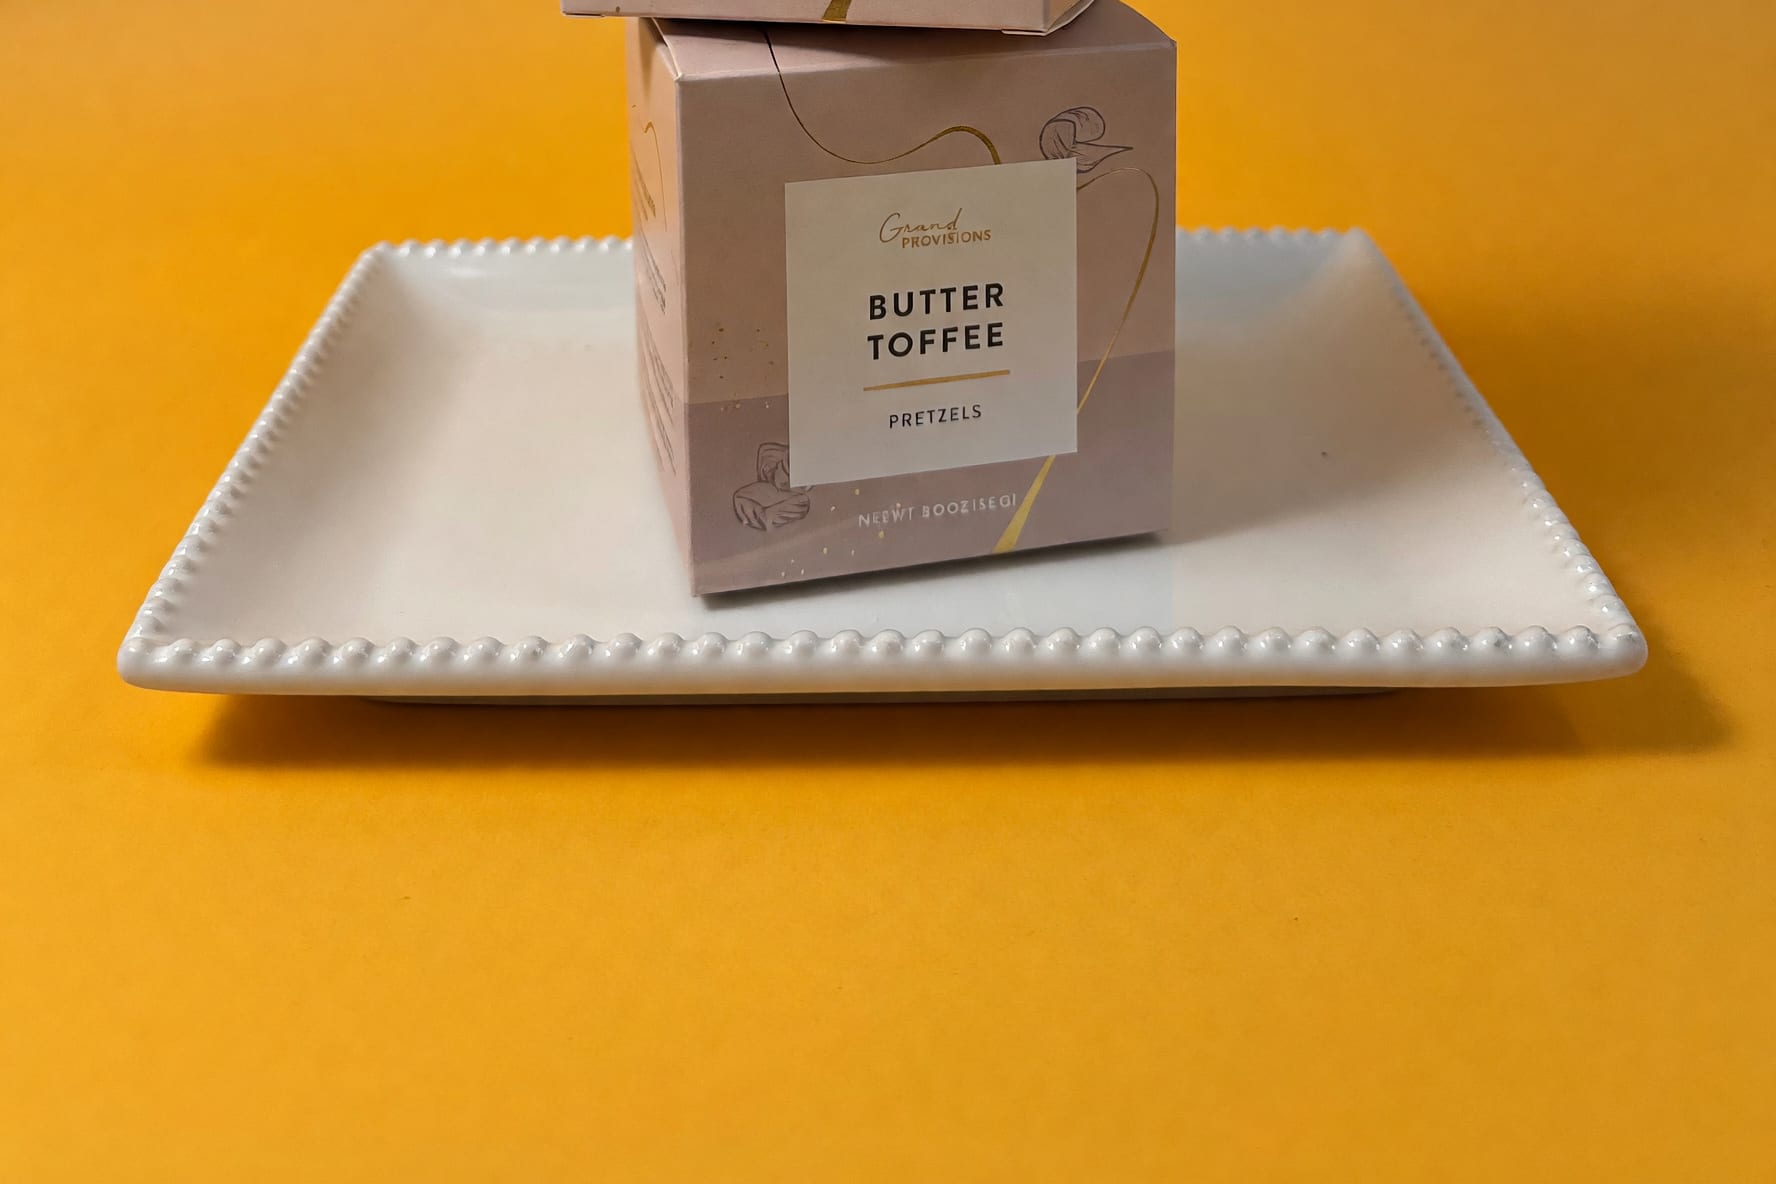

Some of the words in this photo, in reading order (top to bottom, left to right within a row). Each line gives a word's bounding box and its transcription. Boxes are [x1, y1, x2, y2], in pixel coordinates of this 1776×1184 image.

[879, 207, 963, 244] Grand
[902, 229, 992, 249] PROVISIONS
[869, 282, 1004, 320] BUTTER
[867, 321, 1004, 361] TOFFEE
[889, 404, 982, 429] PRETZELS
